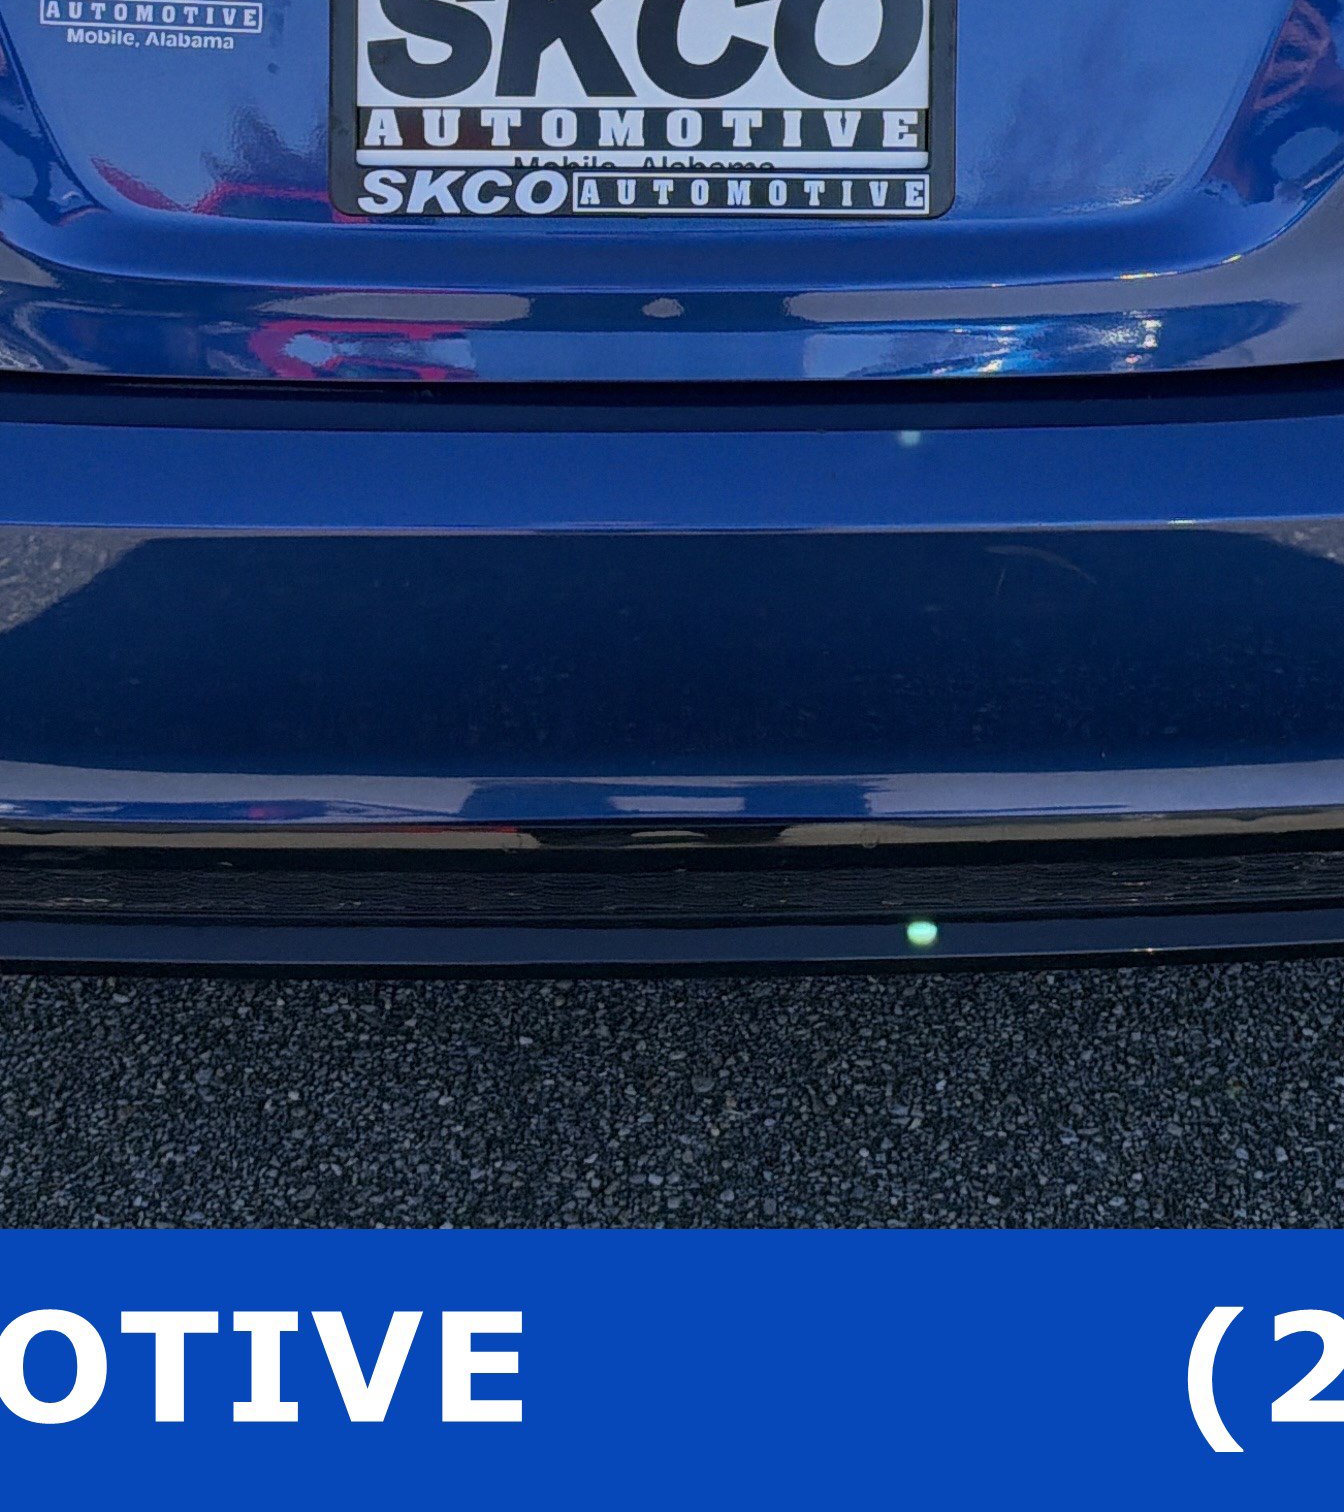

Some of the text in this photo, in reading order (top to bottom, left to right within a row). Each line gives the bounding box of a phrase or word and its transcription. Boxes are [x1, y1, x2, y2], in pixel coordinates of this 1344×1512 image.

[45, 0, 258, 28] AUTOMOTIVE
[66, 27, 235, 50] Mobile, Alabama
[363, 107, 919, 148] AUTOMOTIVE
[357, 168, 926, 215] SKCO AUTOMOTIVE
